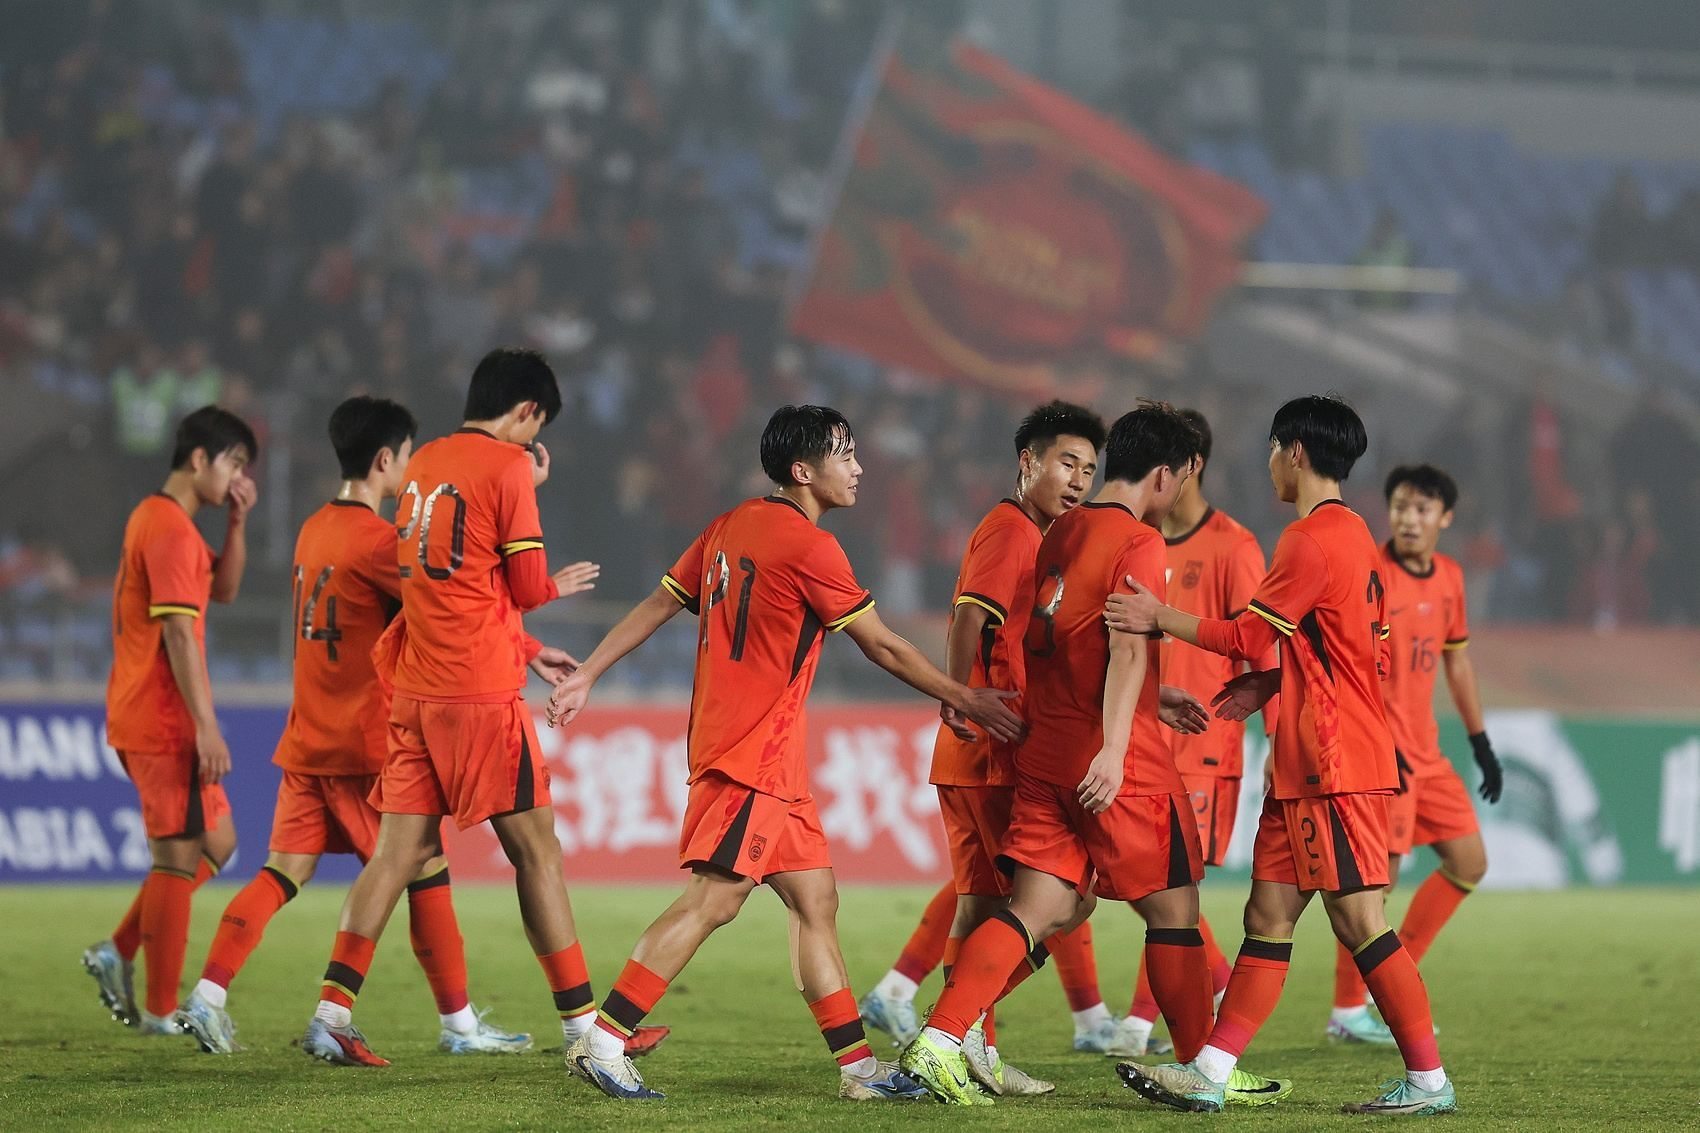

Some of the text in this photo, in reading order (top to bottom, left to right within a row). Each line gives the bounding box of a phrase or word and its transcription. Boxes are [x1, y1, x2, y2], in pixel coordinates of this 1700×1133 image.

[294, 564, 342, 661] 14
[1410, 635, 1436, 673] 16
[1301, 817, 1320, 859] 2
